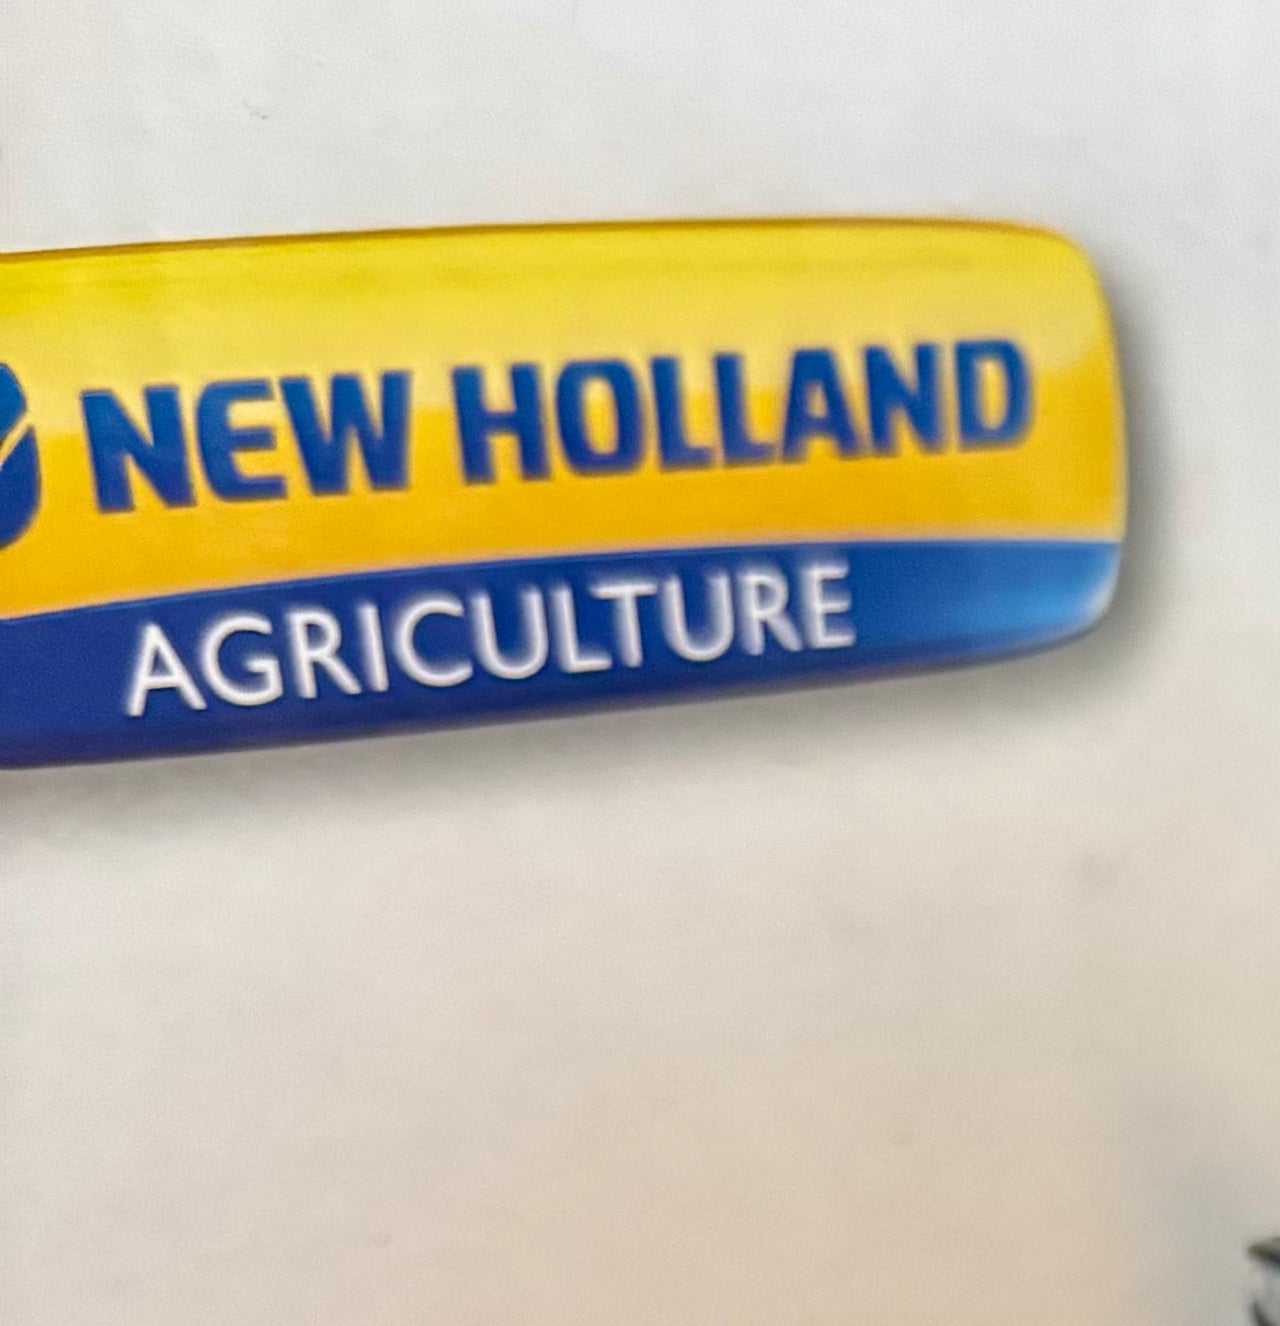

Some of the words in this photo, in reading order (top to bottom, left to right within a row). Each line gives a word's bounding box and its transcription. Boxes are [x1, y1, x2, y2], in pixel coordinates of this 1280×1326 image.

[80, 370, 412, 514] NEW
[452, 338, 1034, 485] HOLLAND
[126, 561, 856, 716] AGRICULTURE
